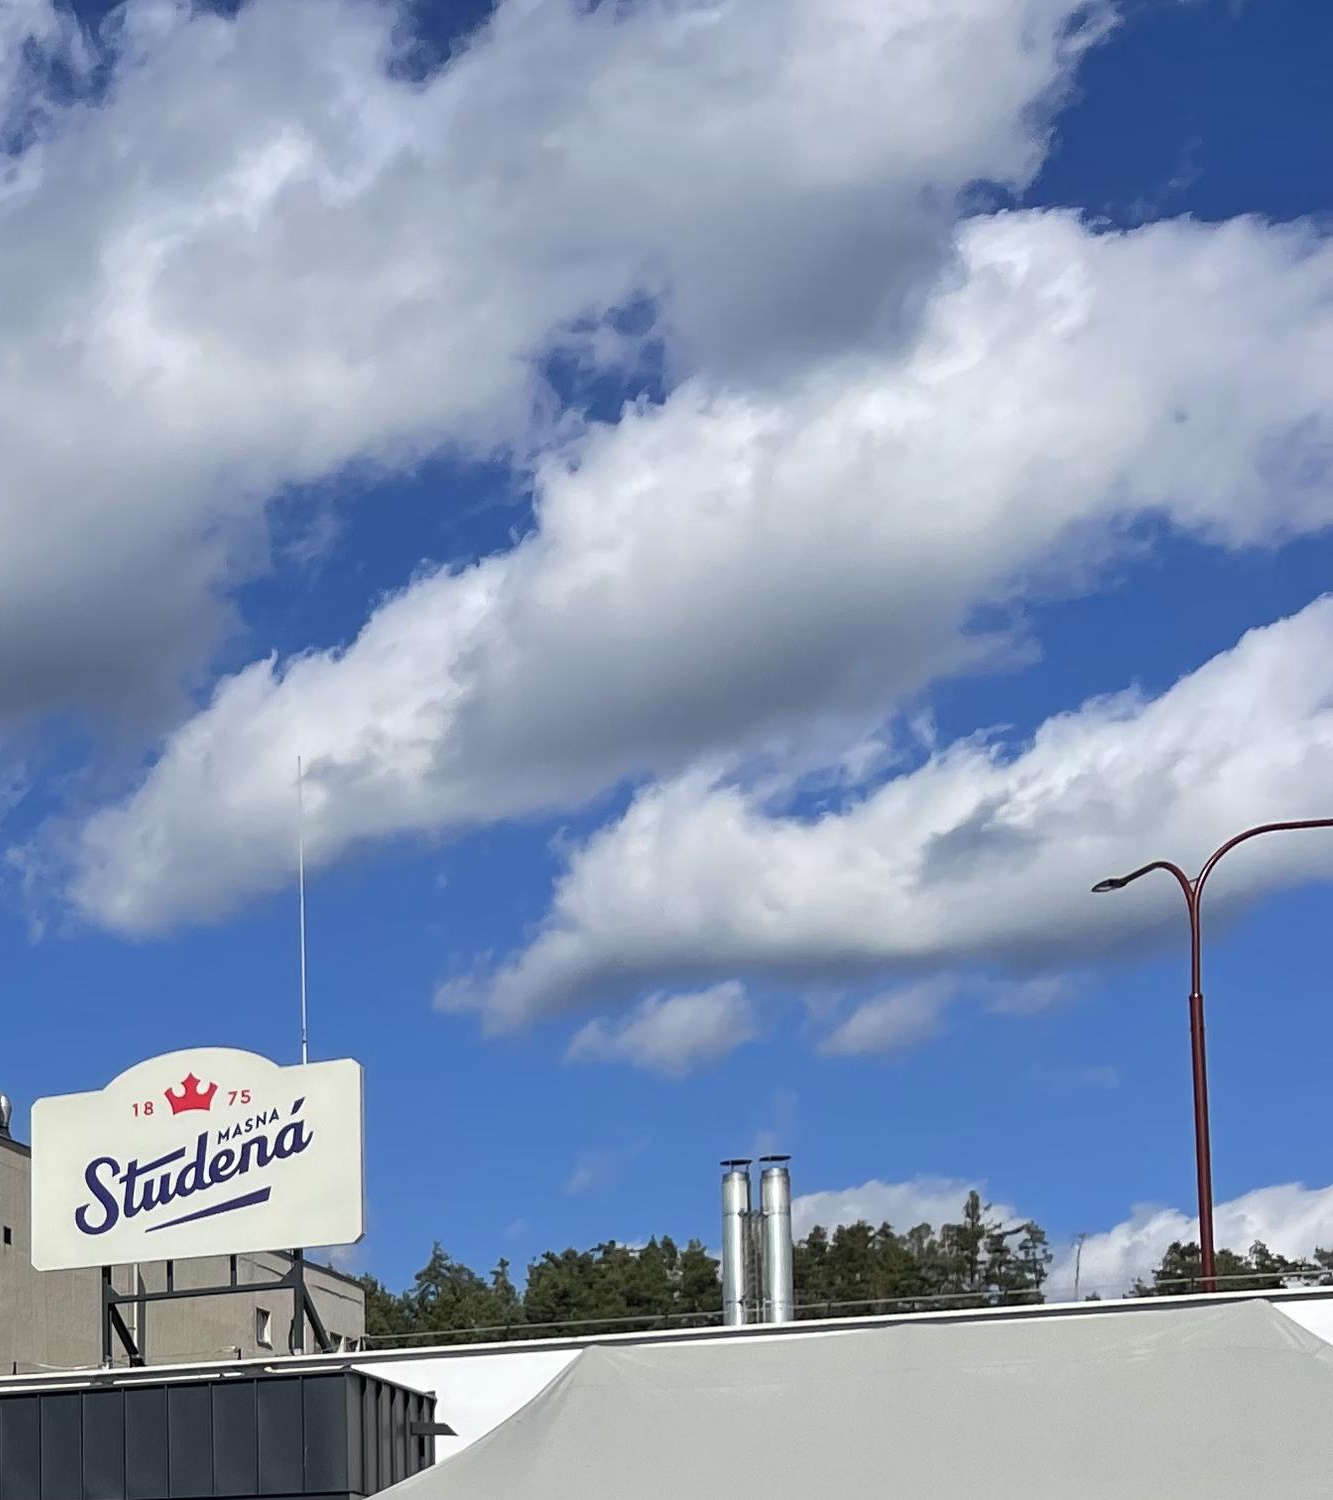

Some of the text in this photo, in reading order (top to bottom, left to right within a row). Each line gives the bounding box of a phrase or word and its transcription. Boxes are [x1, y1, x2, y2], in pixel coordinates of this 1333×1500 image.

[132, 1089, 251, 1117] 18 75
[217, 1110, 280, 1145] MASNA
[75, 1096, 314, 1235] Studená
